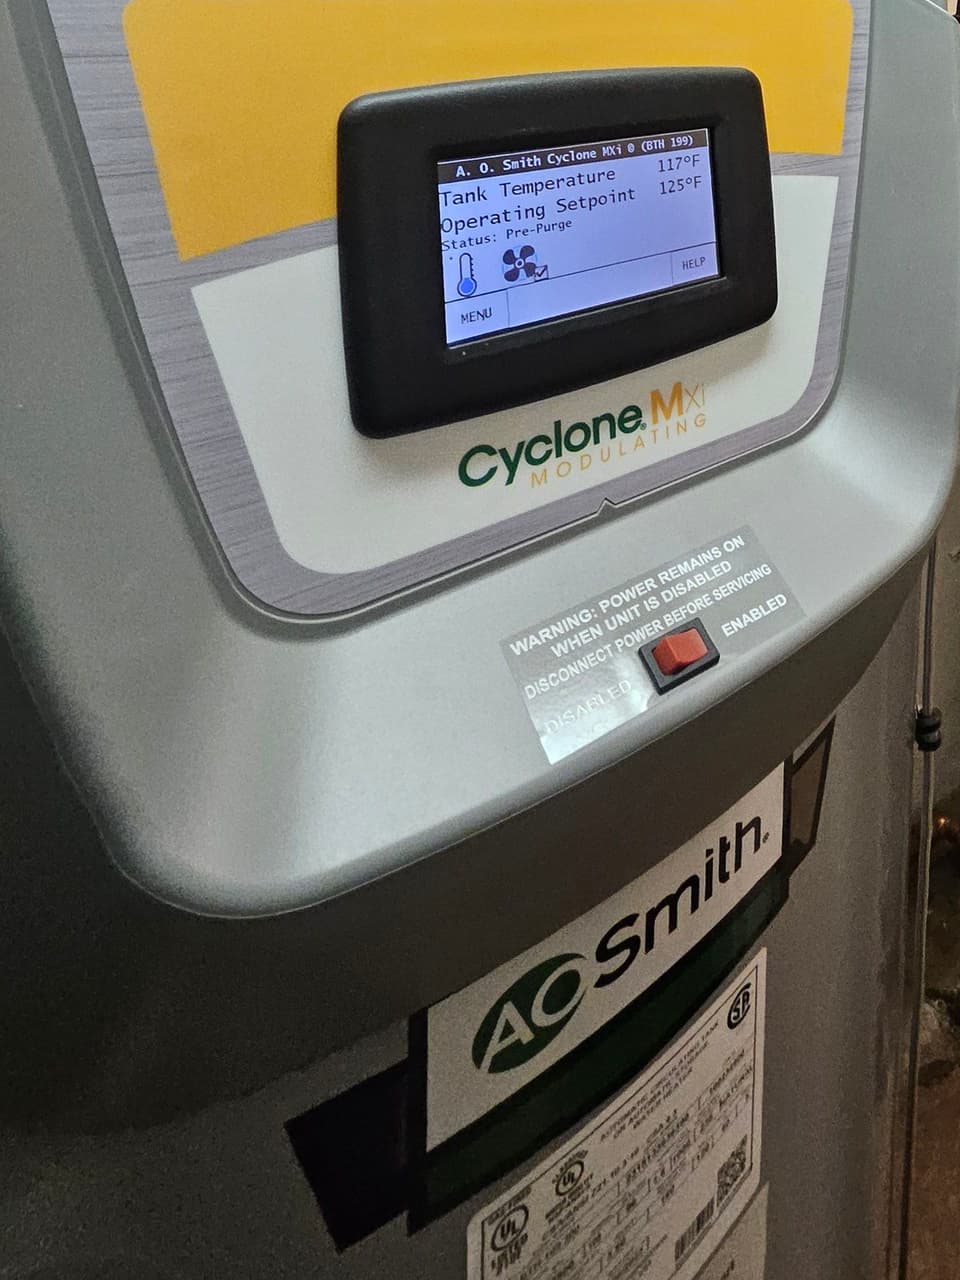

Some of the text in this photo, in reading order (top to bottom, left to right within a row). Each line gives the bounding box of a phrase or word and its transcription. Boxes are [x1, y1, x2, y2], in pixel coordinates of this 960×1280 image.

[455, 165, 471, 178] A.
[502, 155, 542, 171] Smith
[547, 148, 597, 166] Cyclone
[602, 142, 623, 158] MXi
[641, 138, 665, 153] (BTH
[671, 135, 694, 148] 199)
[440, 186, 487, 207] Tank
[500, 170, 616, 200] Temperature
[441, 204, 545, 236] Operating
[556, 188, 636, 213] Setpoint
[441, 218, 573, 252] Status: Pre-Purge
[682, 257, 706, 270] HELP
[460, 308, 493, 325] MENU
[458, 405, 643, 488] Cyclone
[530, 414, 707, 489] MODULATING
[510, 535, 746, 657] WARNING: POWER REMAINS ON
[550, 559, 732, 659] WHEN UNIT IS DISABLED
[523, 562, 772, 701] DISCONNECT POWER BEFORE SERVICING
[547, 592, 788, 736] DISABLED ENABLED
